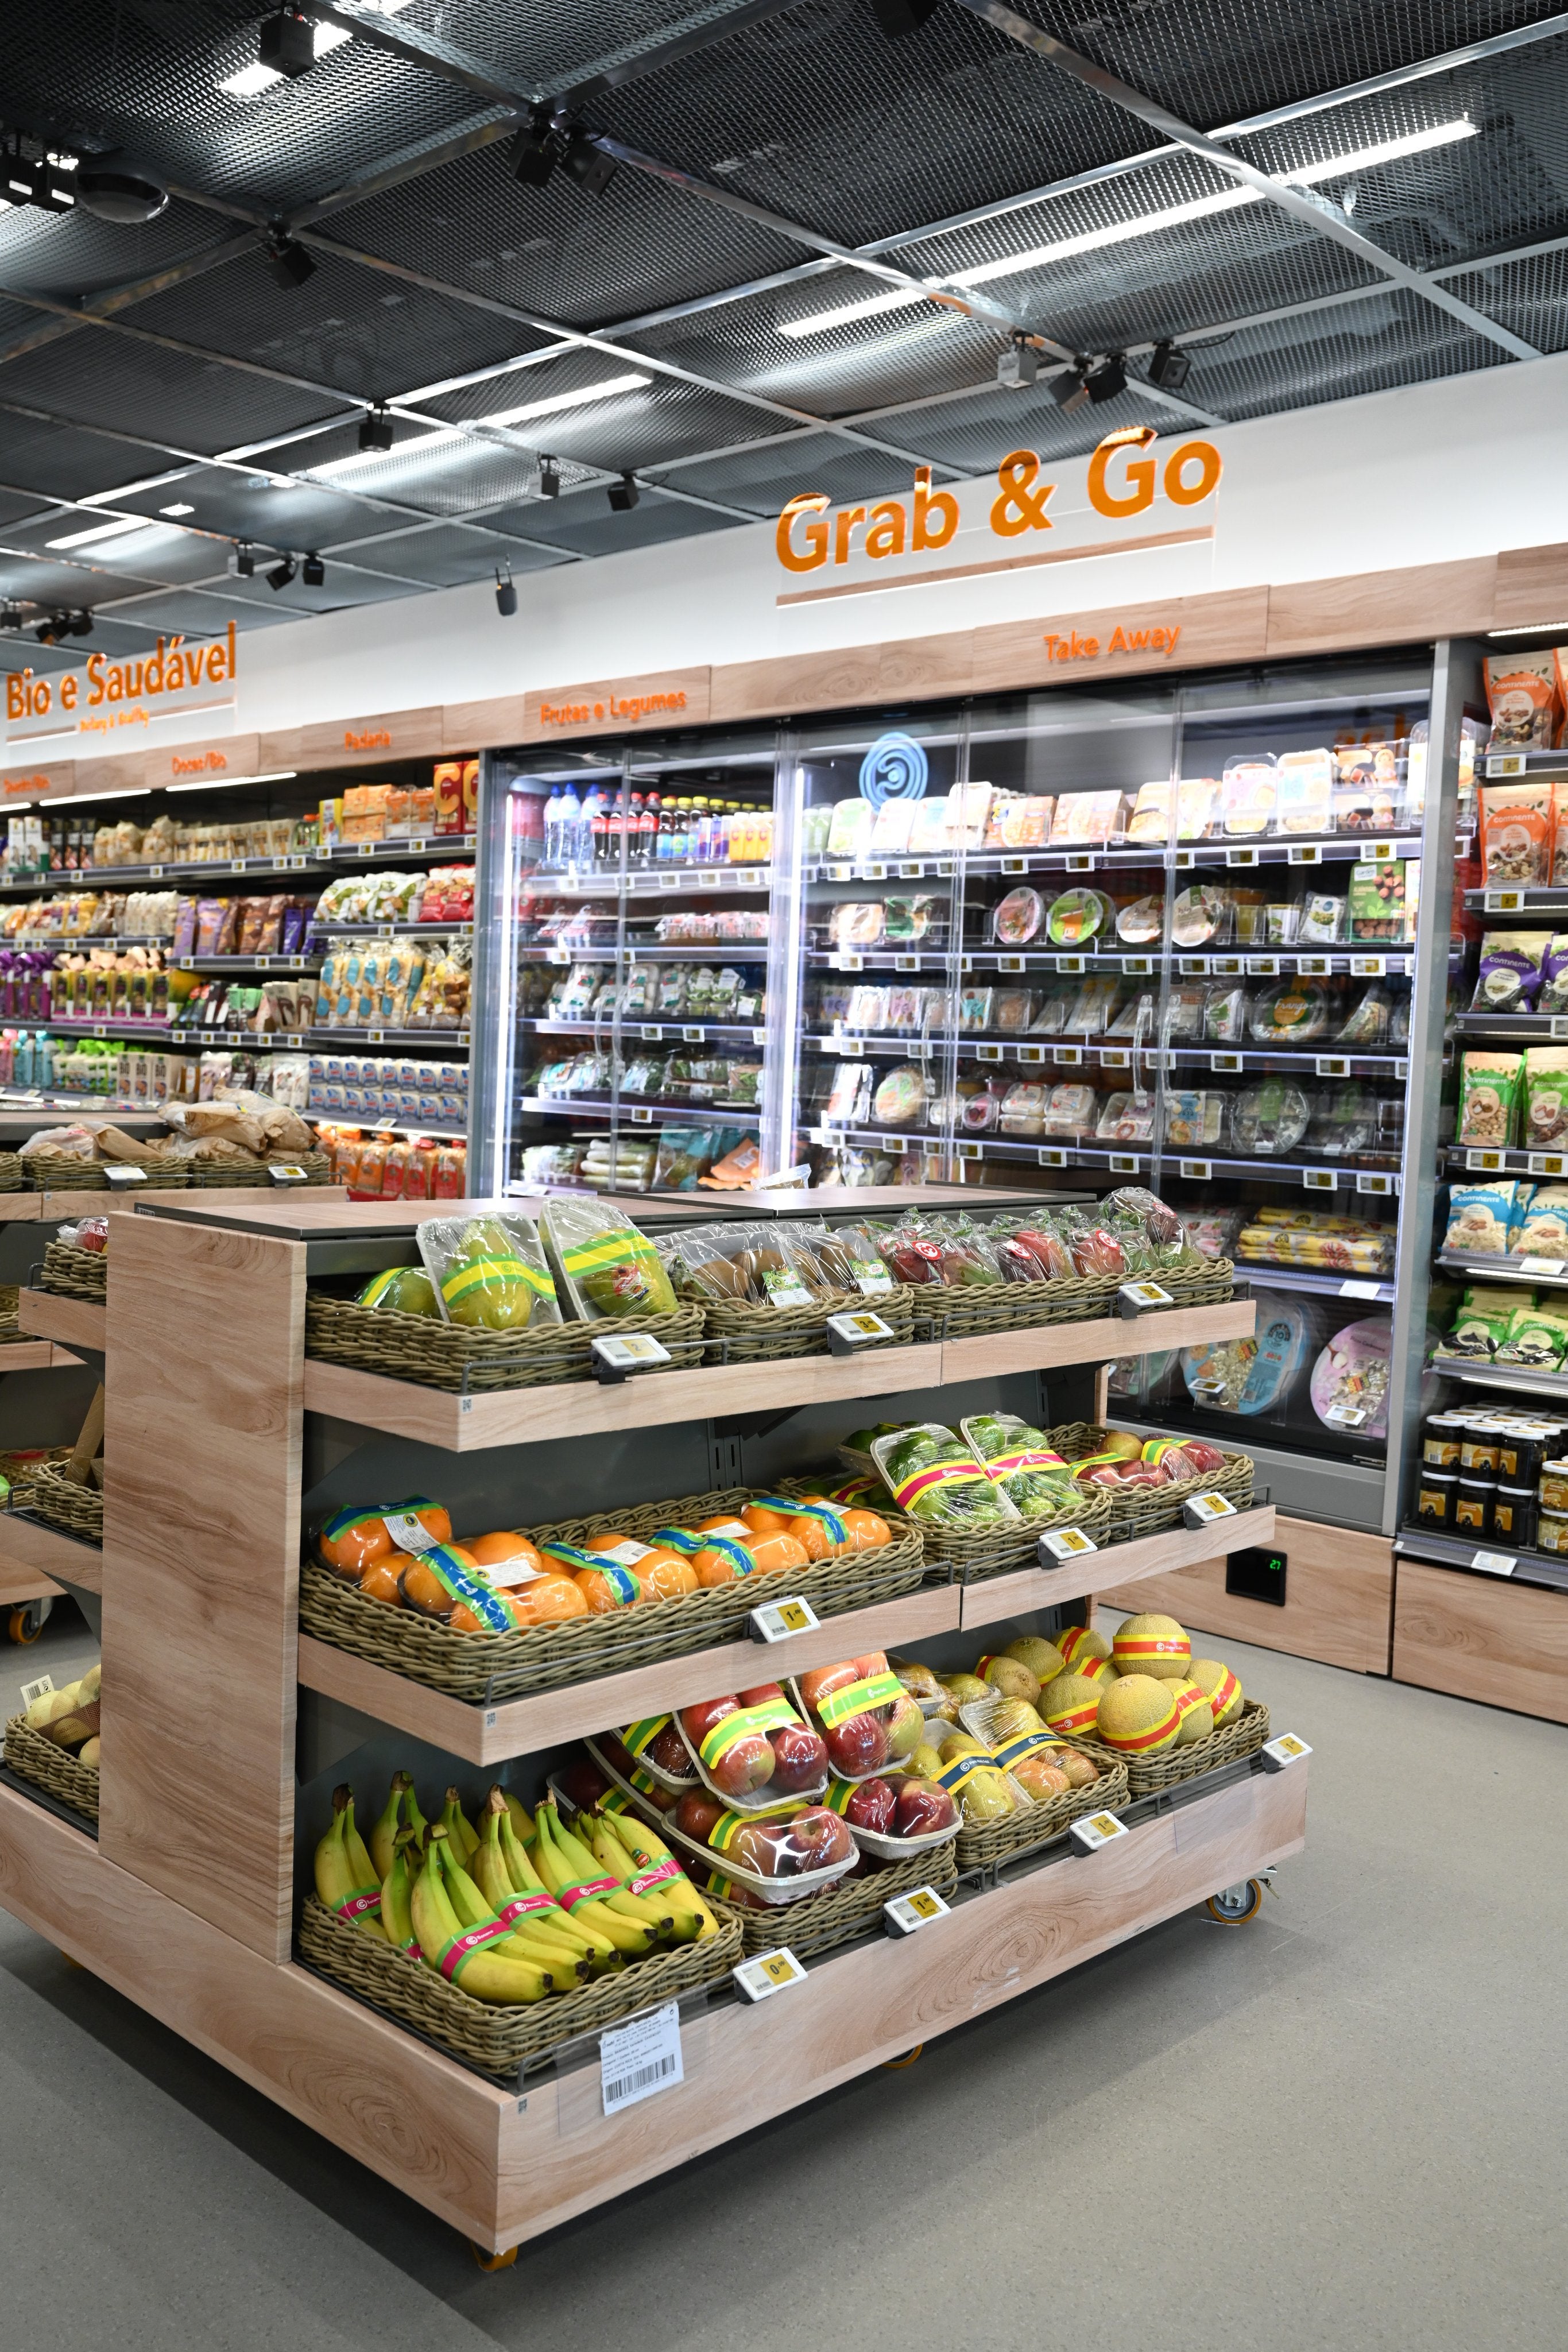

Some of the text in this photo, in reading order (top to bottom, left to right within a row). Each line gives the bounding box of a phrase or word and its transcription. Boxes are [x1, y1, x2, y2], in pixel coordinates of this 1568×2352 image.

[776, 426, 1224, 574] Grab & Go
[1044, 625, 1181, 662] Take Away
[6, 620, 237, 720] Bio e Saudável
[540, 691, 687, 725] Frutas e Legumes
[1493, 814, 1536, 823] CONTINENTE
[1489, 956, 1530, 969] CONTINENTE
[1457, 1196, 1500, 1204] CONTINENTE
[642, 1876, 659, 1887] Banana
[589, 1884, 605, 1892] Banana
[476, 1929, 494, 1940] Banana
